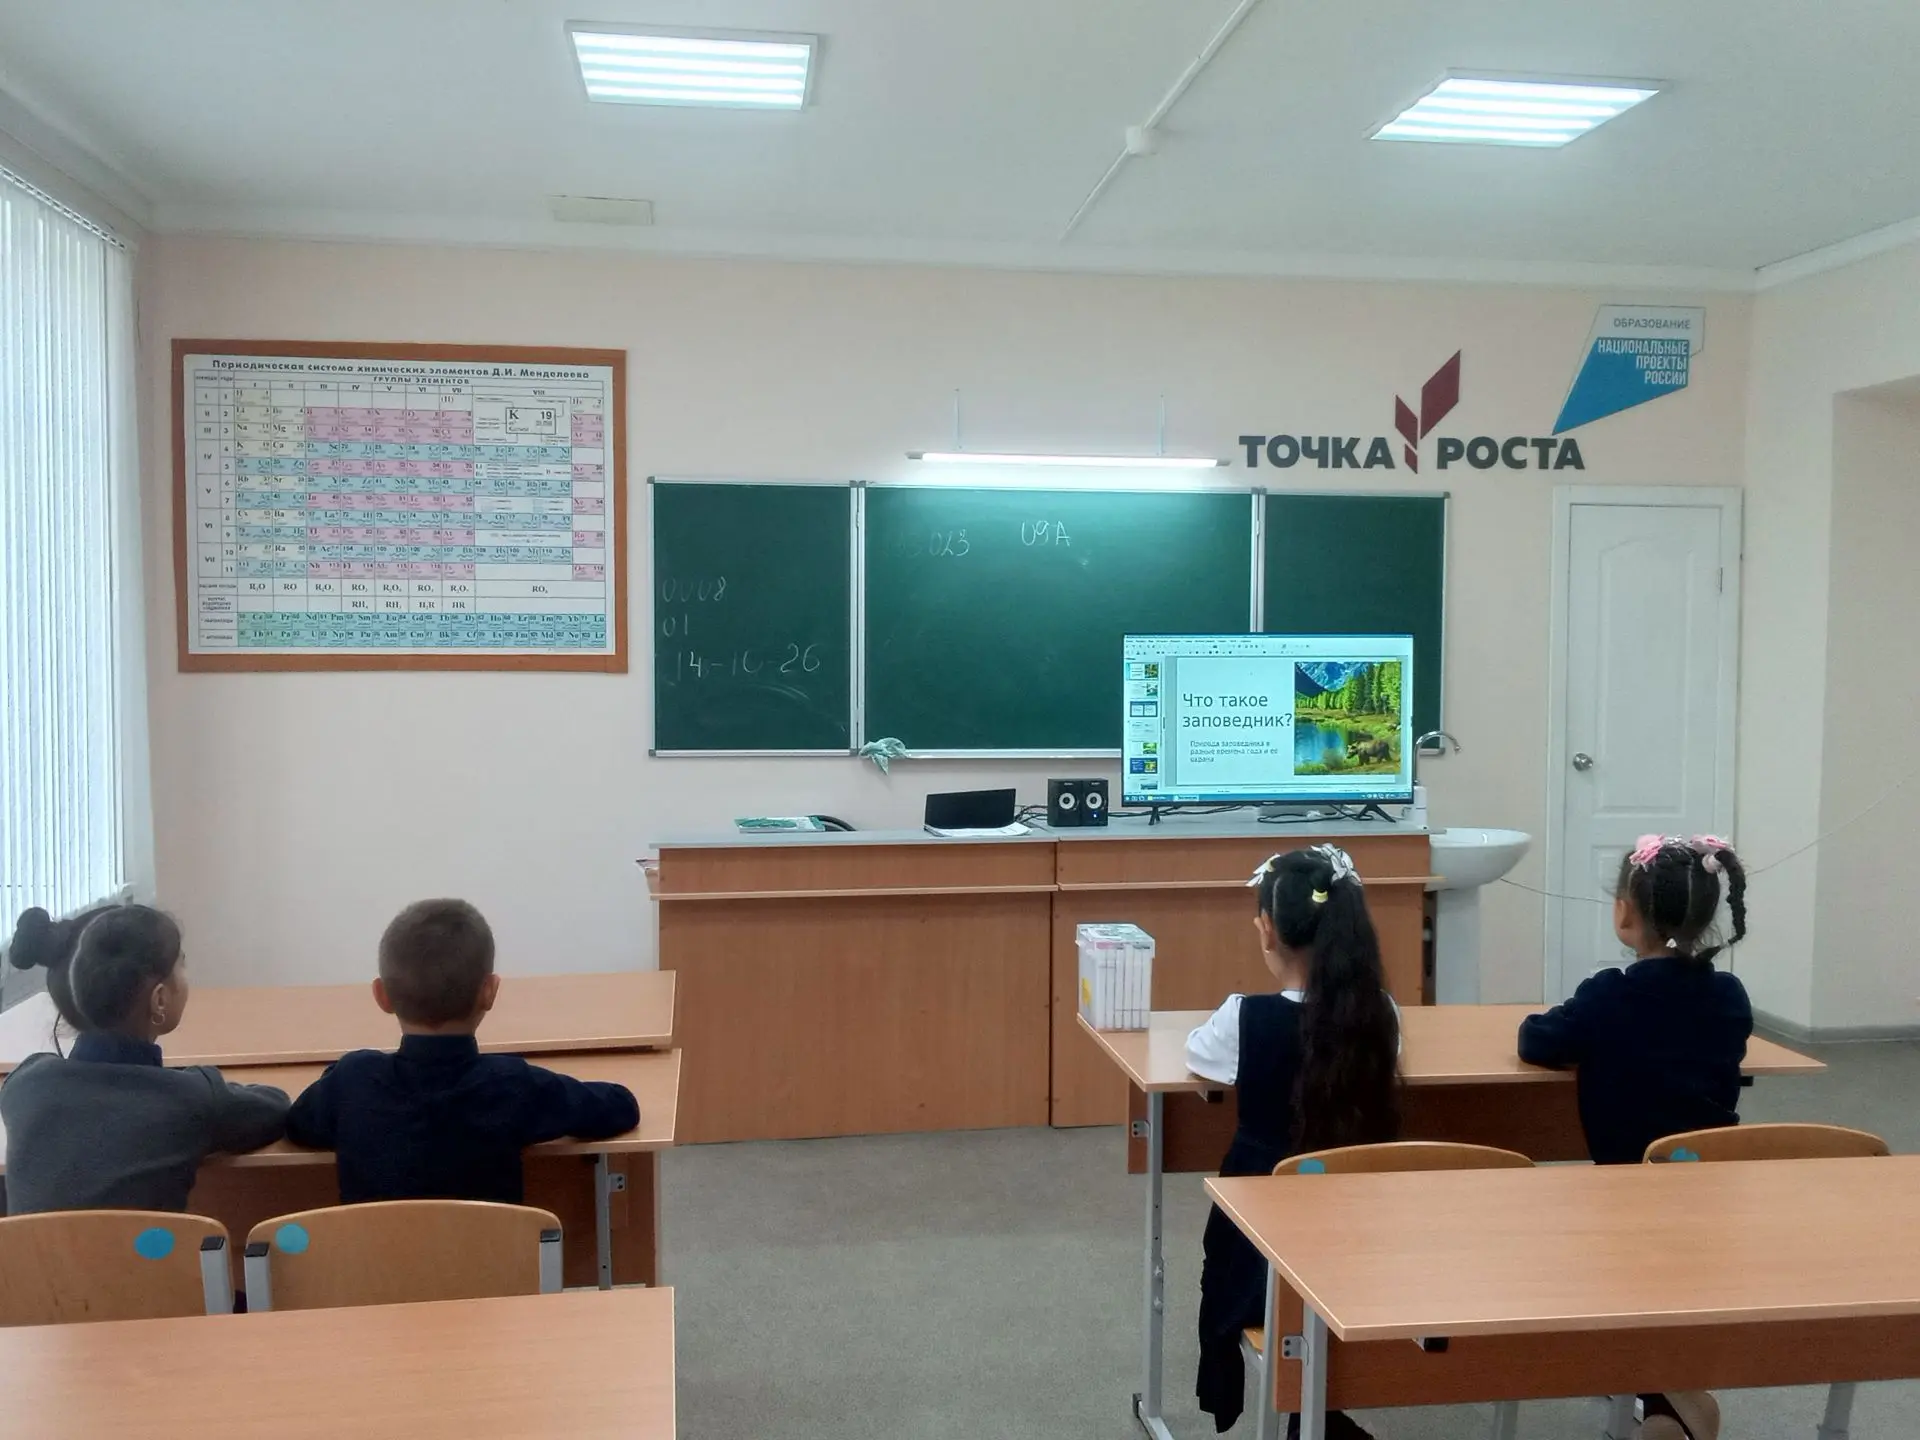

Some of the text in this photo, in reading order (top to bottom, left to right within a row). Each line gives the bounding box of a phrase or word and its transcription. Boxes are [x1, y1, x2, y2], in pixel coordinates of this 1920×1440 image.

[1612, 317, 1691, 330] ОБРАЗОВАНИЕ
[1597, 339, 1688, 357] НАЦИОНАЛЬНЫЕ
[212, 359, 304, 371] Периодическая
[307, 362, 353, 373] система
[357, 364, 426, 375] химических
[429, 367, 489, 376] элементов
[492, 368, 517, 377] Д.И.
[1635, 355, 1687, 371] ПРОЕКТЫ
[415, 377, 470, 385] ЭЛЕМЕНТОВ
[1644, 370, 1687, 386] РОССИИ
[508, 409, 553, 420] K 19
[1239, 433, 1586, 470] ТОЧКА РОСТА
[662, 612, 689, 639] 01
[332, 631, 345, 639] Np
[1183, 693, 1268, 708] Что такое
[1182, 712, 1293, 729] заповедник?
